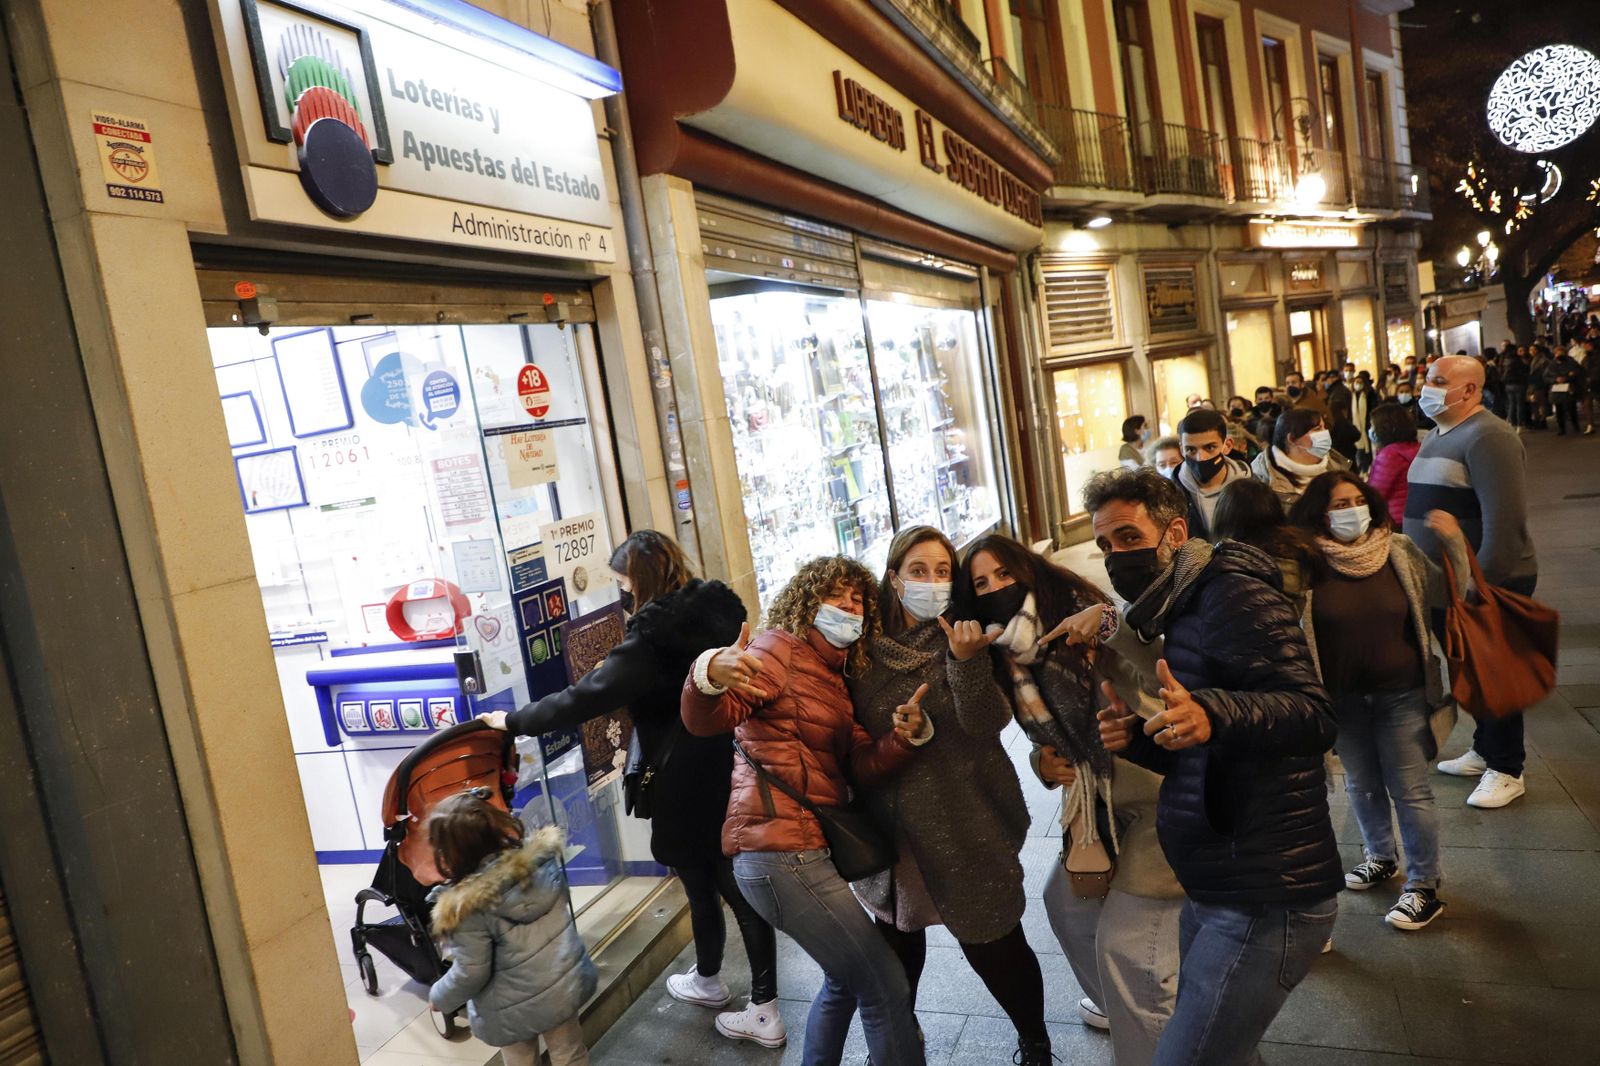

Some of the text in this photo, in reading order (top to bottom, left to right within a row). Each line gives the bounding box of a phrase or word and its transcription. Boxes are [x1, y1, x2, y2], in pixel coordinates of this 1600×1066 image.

[387, 67, 500, 134] Loterías y
[94, 114, 145, 130] VIDEO-ALARMA
[403, 129, 601, 201] Apuestas del Estado
[109, 186, 161, 201] 902 114 573
[452, 211, 573, 249] Administración
[599, 235, 607, 253] 4
[522, 369, 542, 388] +18
[309, 446, 371, 470] 12061
[437, 456, 471, 469] BOTES
[560, 519, 595, 538] PREMIO
[554, 534, 595, 564] 72897
[545, 735, 570, 757] Estado
